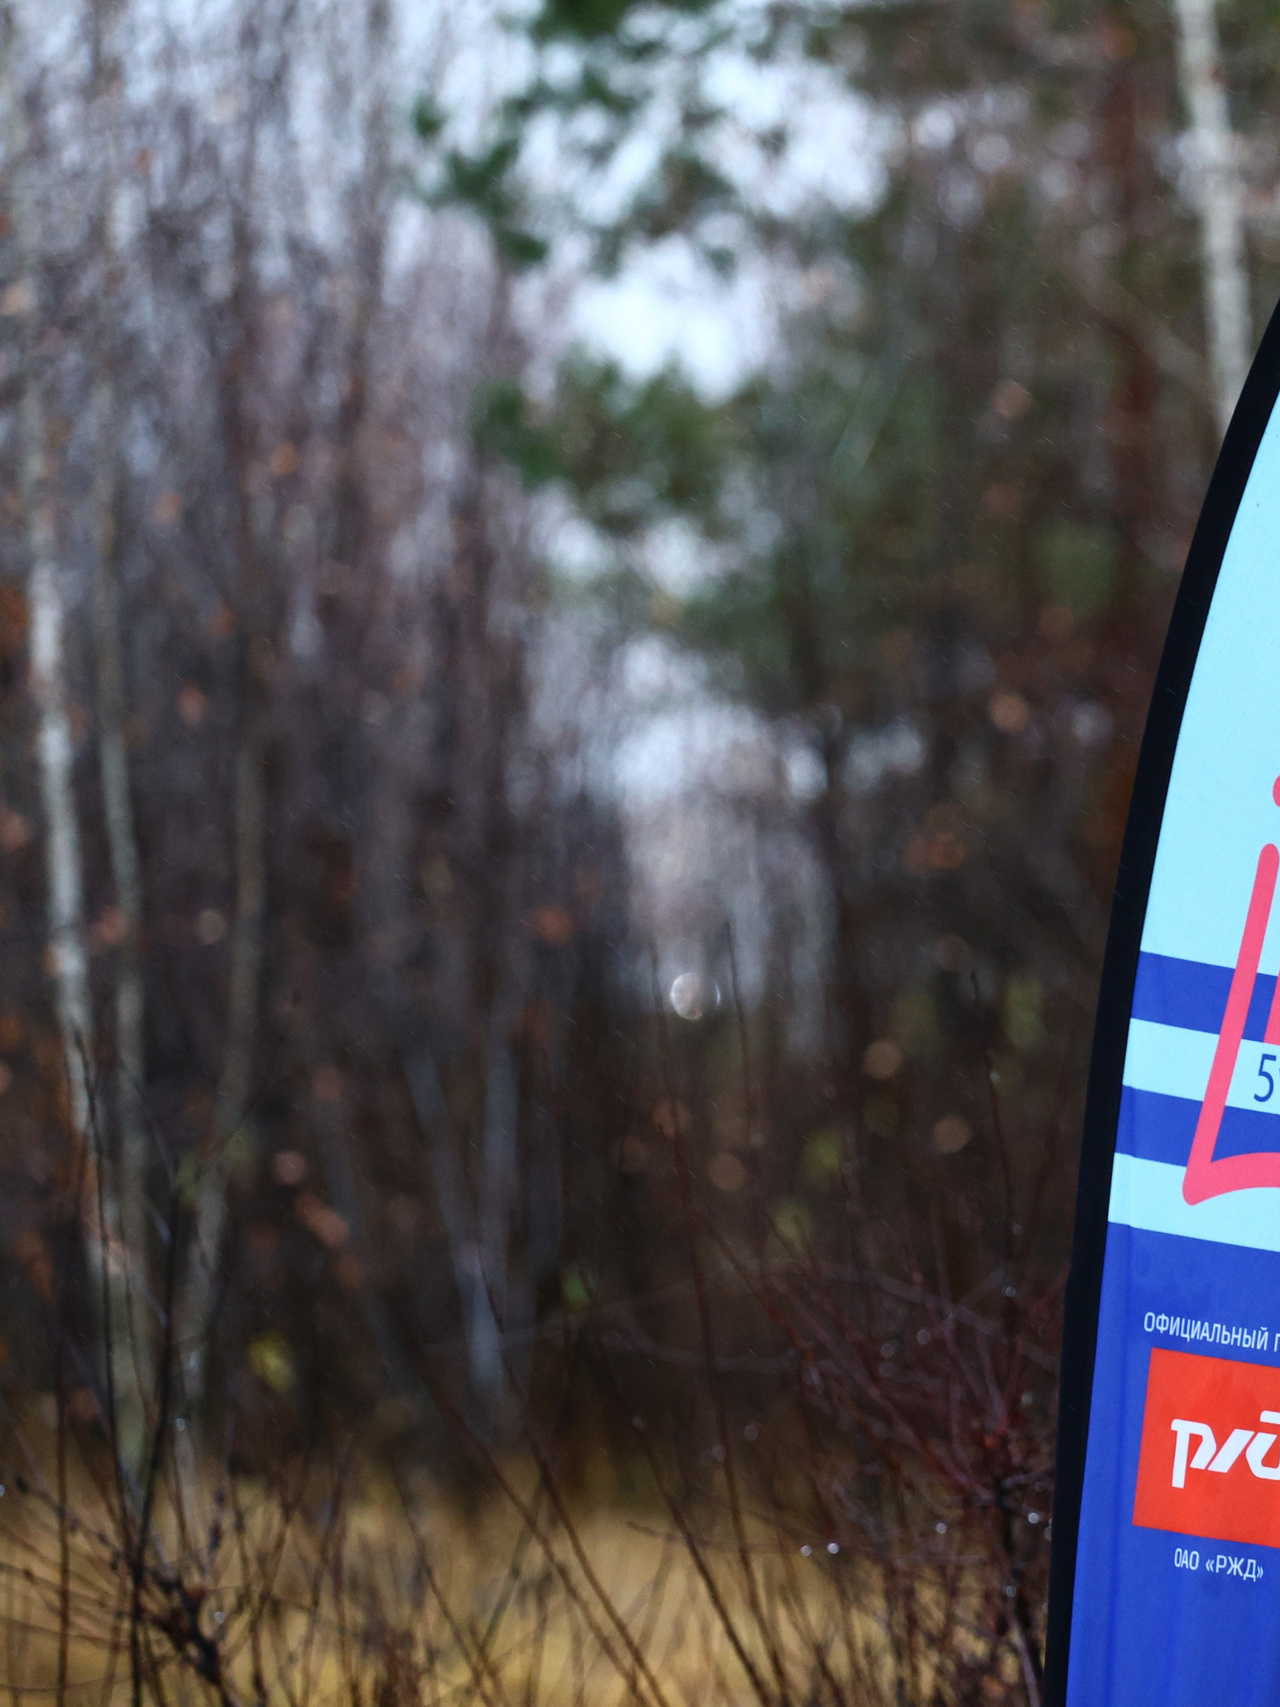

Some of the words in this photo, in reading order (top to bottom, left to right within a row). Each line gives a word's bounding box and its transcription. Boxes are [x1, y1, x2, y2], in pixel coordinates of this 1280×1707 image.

[1143, 1311, 1269, 1351] ОФИЦИАЛЬНЫЙ
[1173, 1547, 1200, 1571] ОАО
[1204, 1554, 1264, 1582] «РЖД»
